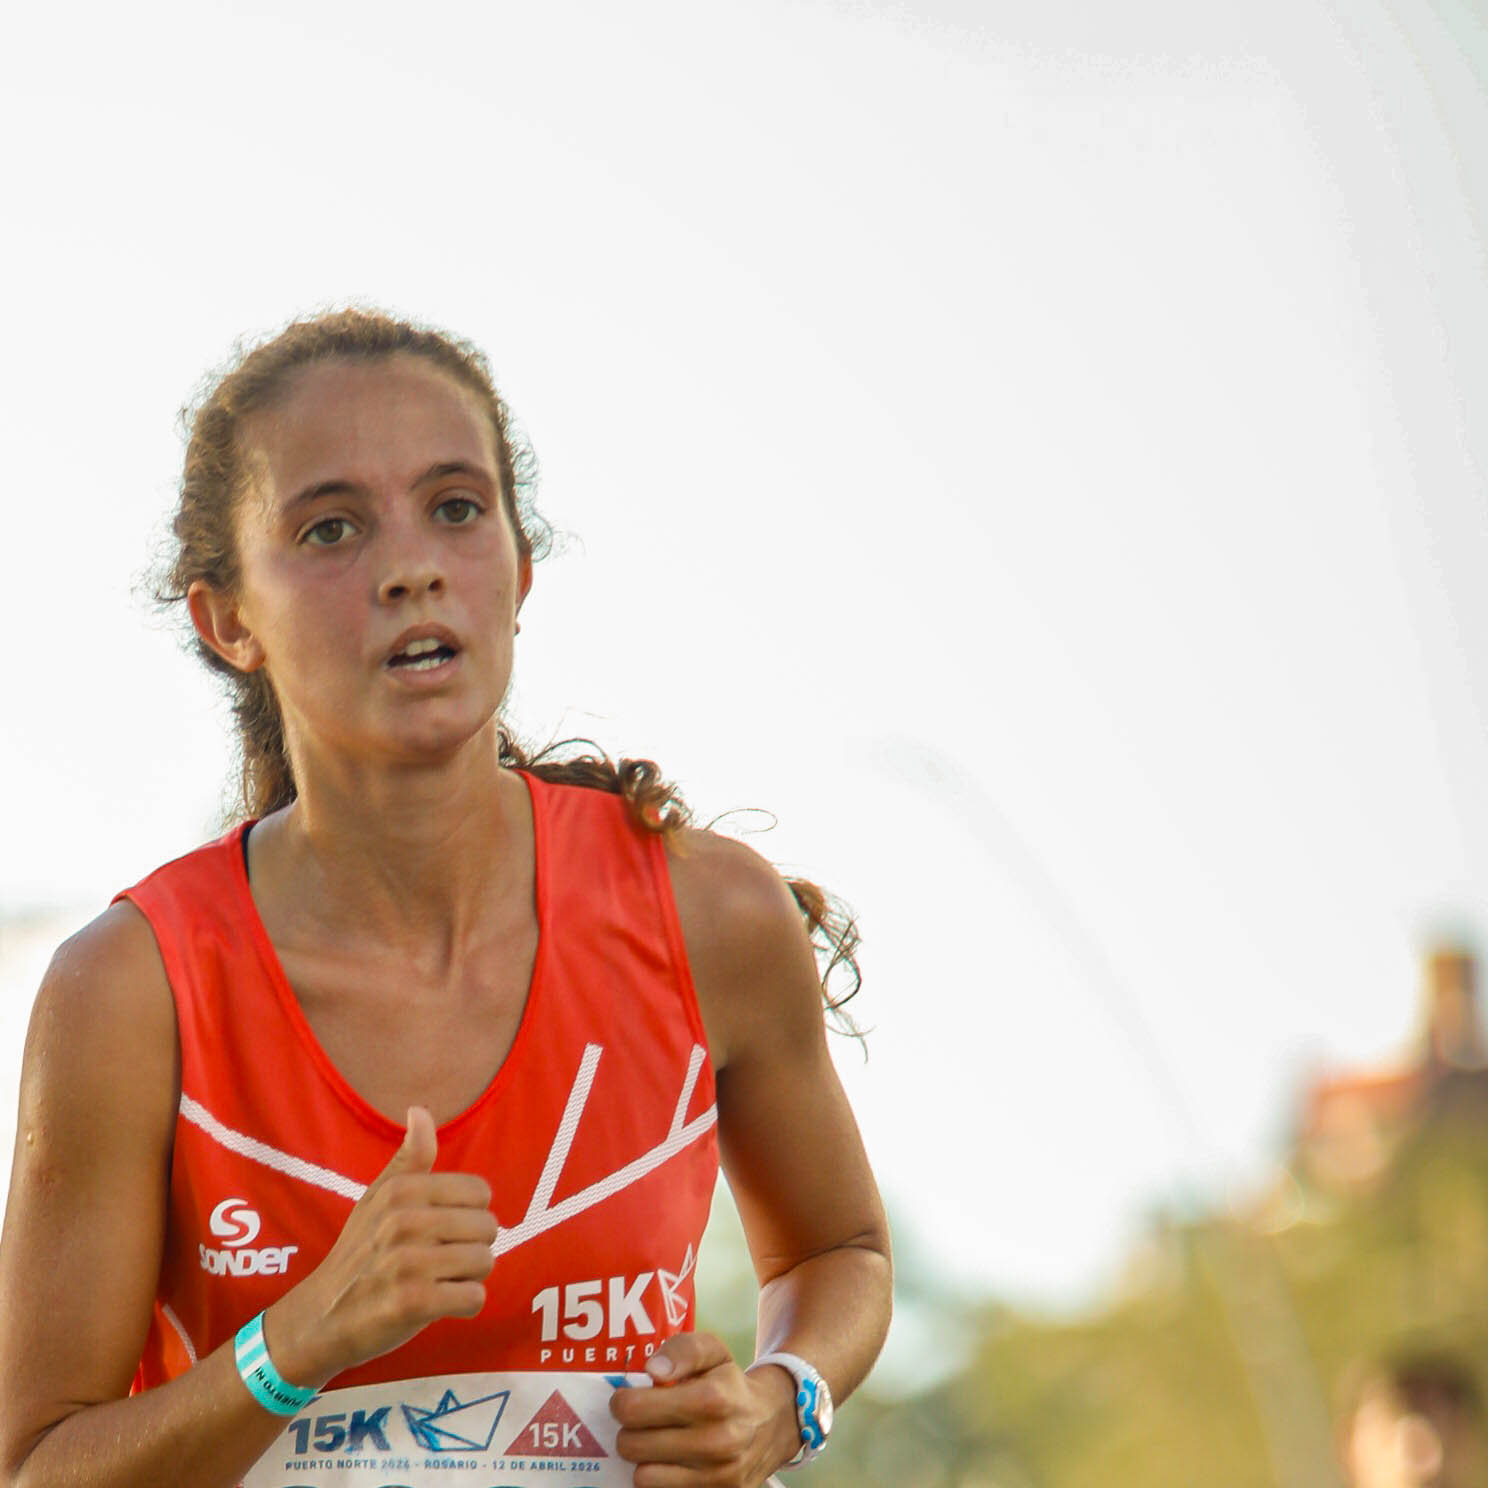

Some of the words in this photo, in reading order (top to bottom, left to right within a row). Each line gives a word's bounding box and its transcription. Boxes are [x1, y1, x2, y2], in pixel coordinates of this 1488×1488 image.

[531, 1271, 656, 1342] 15K
[540, 1343, 654, 1363] PUERTO
[288, 1406, 392, 1455] 15K
[528, 1422, 583, 1449] 15K
[285, 1459, 332, 1471] PUERTO
[336, 1458, 377, 1470] NORTE
[424, 1459, 477, 1470] ROSARIO
[492, 1460, 505, 1470] 12
[510, 1461, 525, 1471] DE
[530, 1461, 566, 1471] ABRIL
[570, 1461, 600, 1471] 2026
